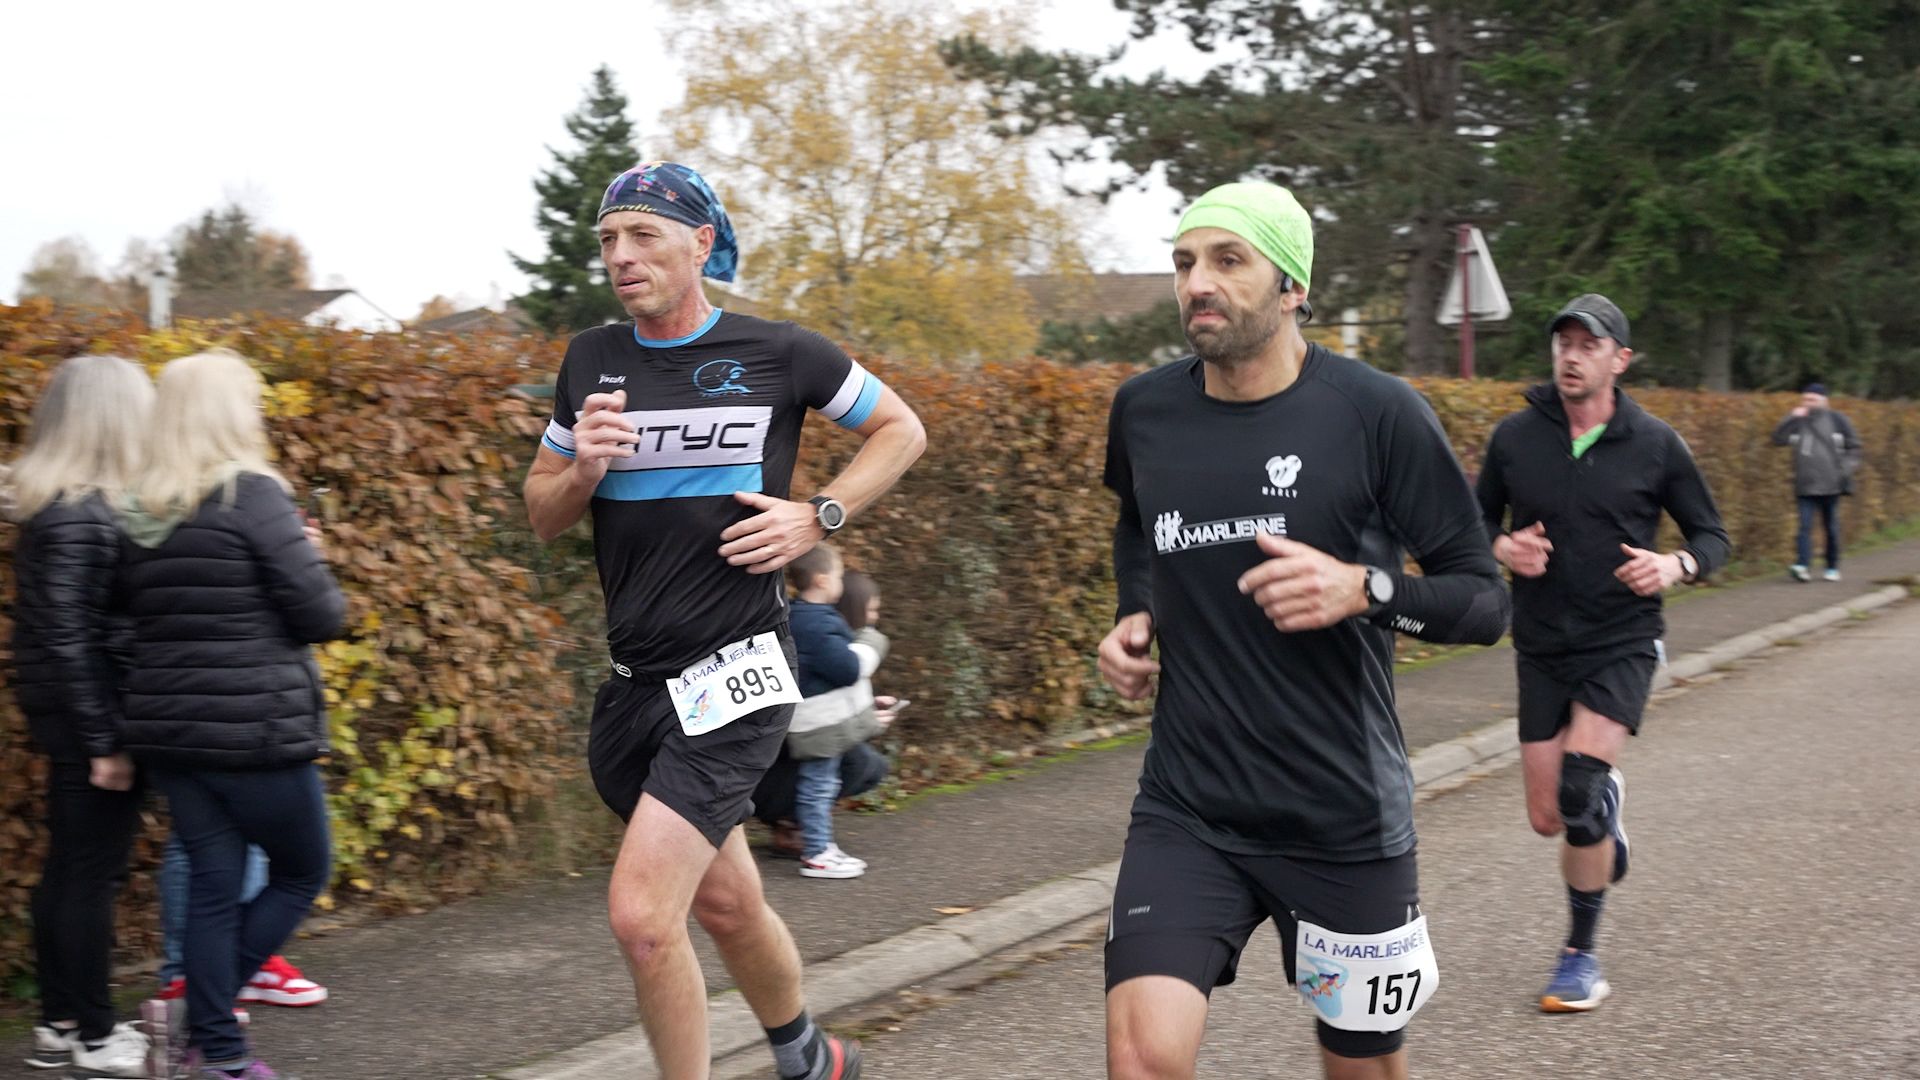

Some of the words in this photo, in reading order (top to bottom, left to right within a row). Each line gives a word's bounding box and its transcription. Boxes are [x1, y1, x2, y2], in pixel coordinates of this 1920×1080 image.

[1183, 517, 1288, 546] MARLIENNE
[675, 675, 691, 695] LA
[725, 667, 783, 704] 895
[1304, 933, 1326, 953] LA
[1367, 969, 1421, 1015] 157
